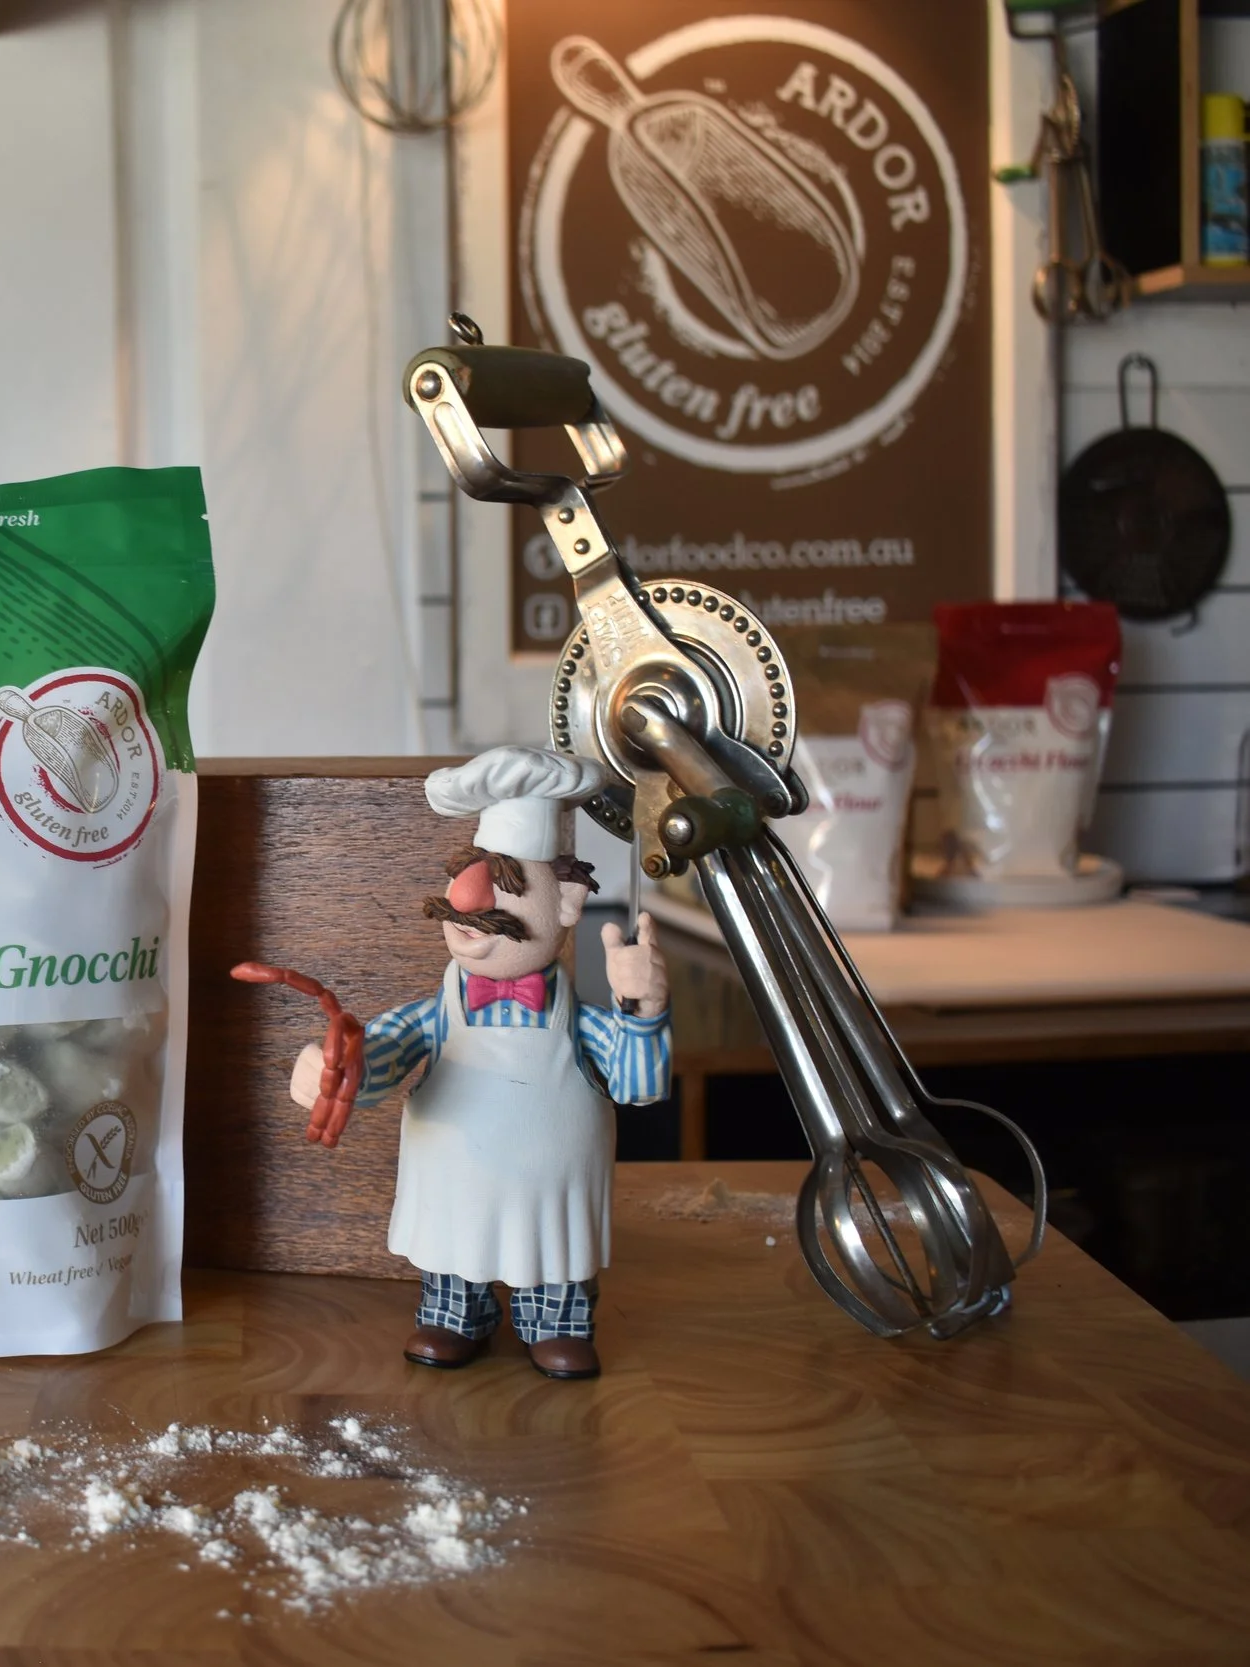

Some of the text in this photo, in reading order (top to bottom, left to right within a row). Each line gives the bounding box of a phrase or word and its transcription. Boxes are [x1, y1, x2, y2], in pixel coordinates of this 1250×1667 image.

[776, 62, 931, 232] ARDOR
[582, 301, 822, 440] gluten free
[616, 532, 914, 574] dorfoodco.com.au
[95, 690, 143, 760] ARDOR
[14, 791, 110, 848] gluten free
[79, 1168, 128, 1201] GLUTEN FREE
[73, 1223, 104, 1249] Net
[9, 1270, 63, 1286] Wheat
[64, 1265, 95, 1287] free
